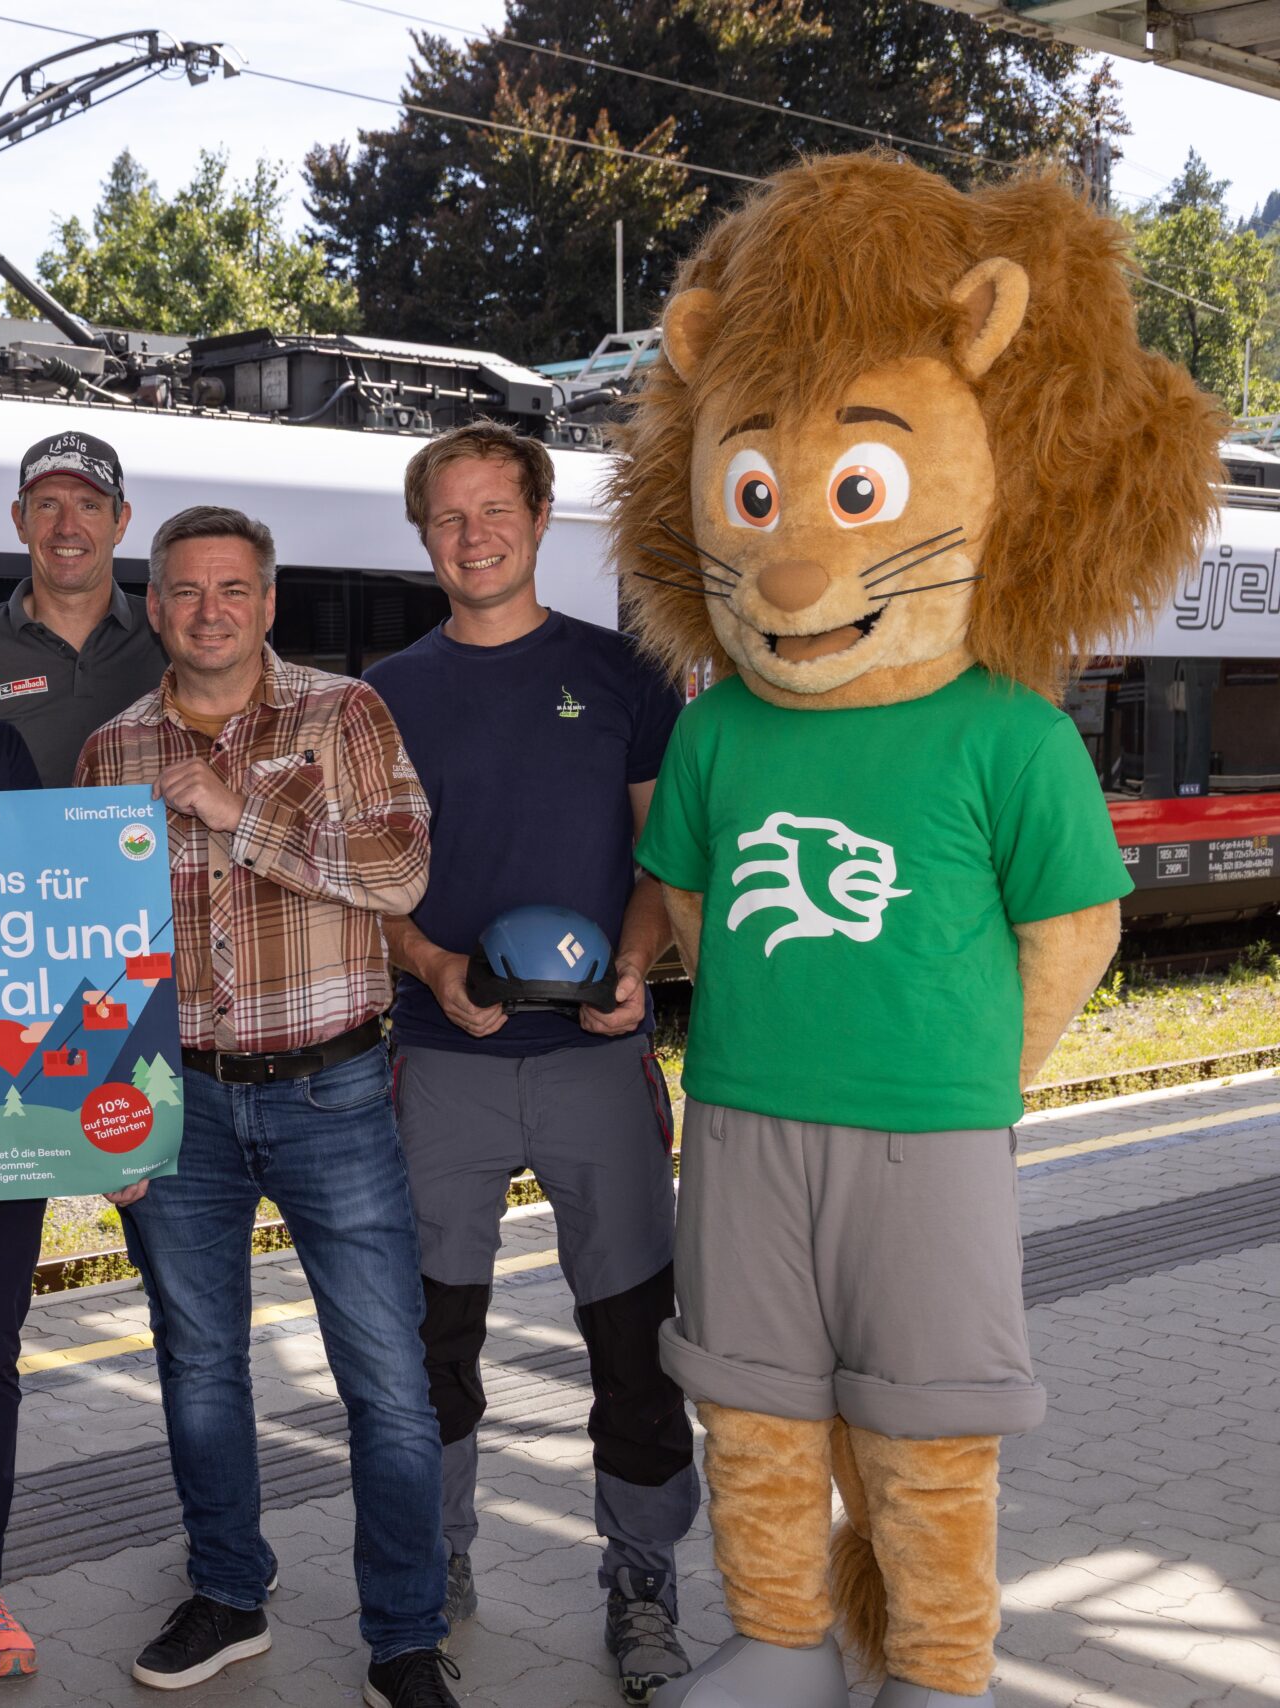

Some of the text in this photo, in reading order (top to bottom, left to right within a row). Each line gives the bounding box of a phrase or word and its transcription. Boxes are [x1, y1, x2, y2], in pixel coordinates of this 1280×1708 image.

[13, 678, 45, 690] saalbach
[64, 804, 154, 821] KlimaTicket
[36, 868, 89, 900] für
[45, 909, 151, 960] und
[97, 1097, 130, 1115] 10%
[83, 1106, 151, 1131] auf Berg- und
[94, 1121, 146, 1140] Talfahrten
[10, 1148, 19, 1159] Ö
[21, 1149, 36, 1158] die
[37, 1148, 71, 1157] Besten
[20, 1171, 56, 1181] nutzen.
